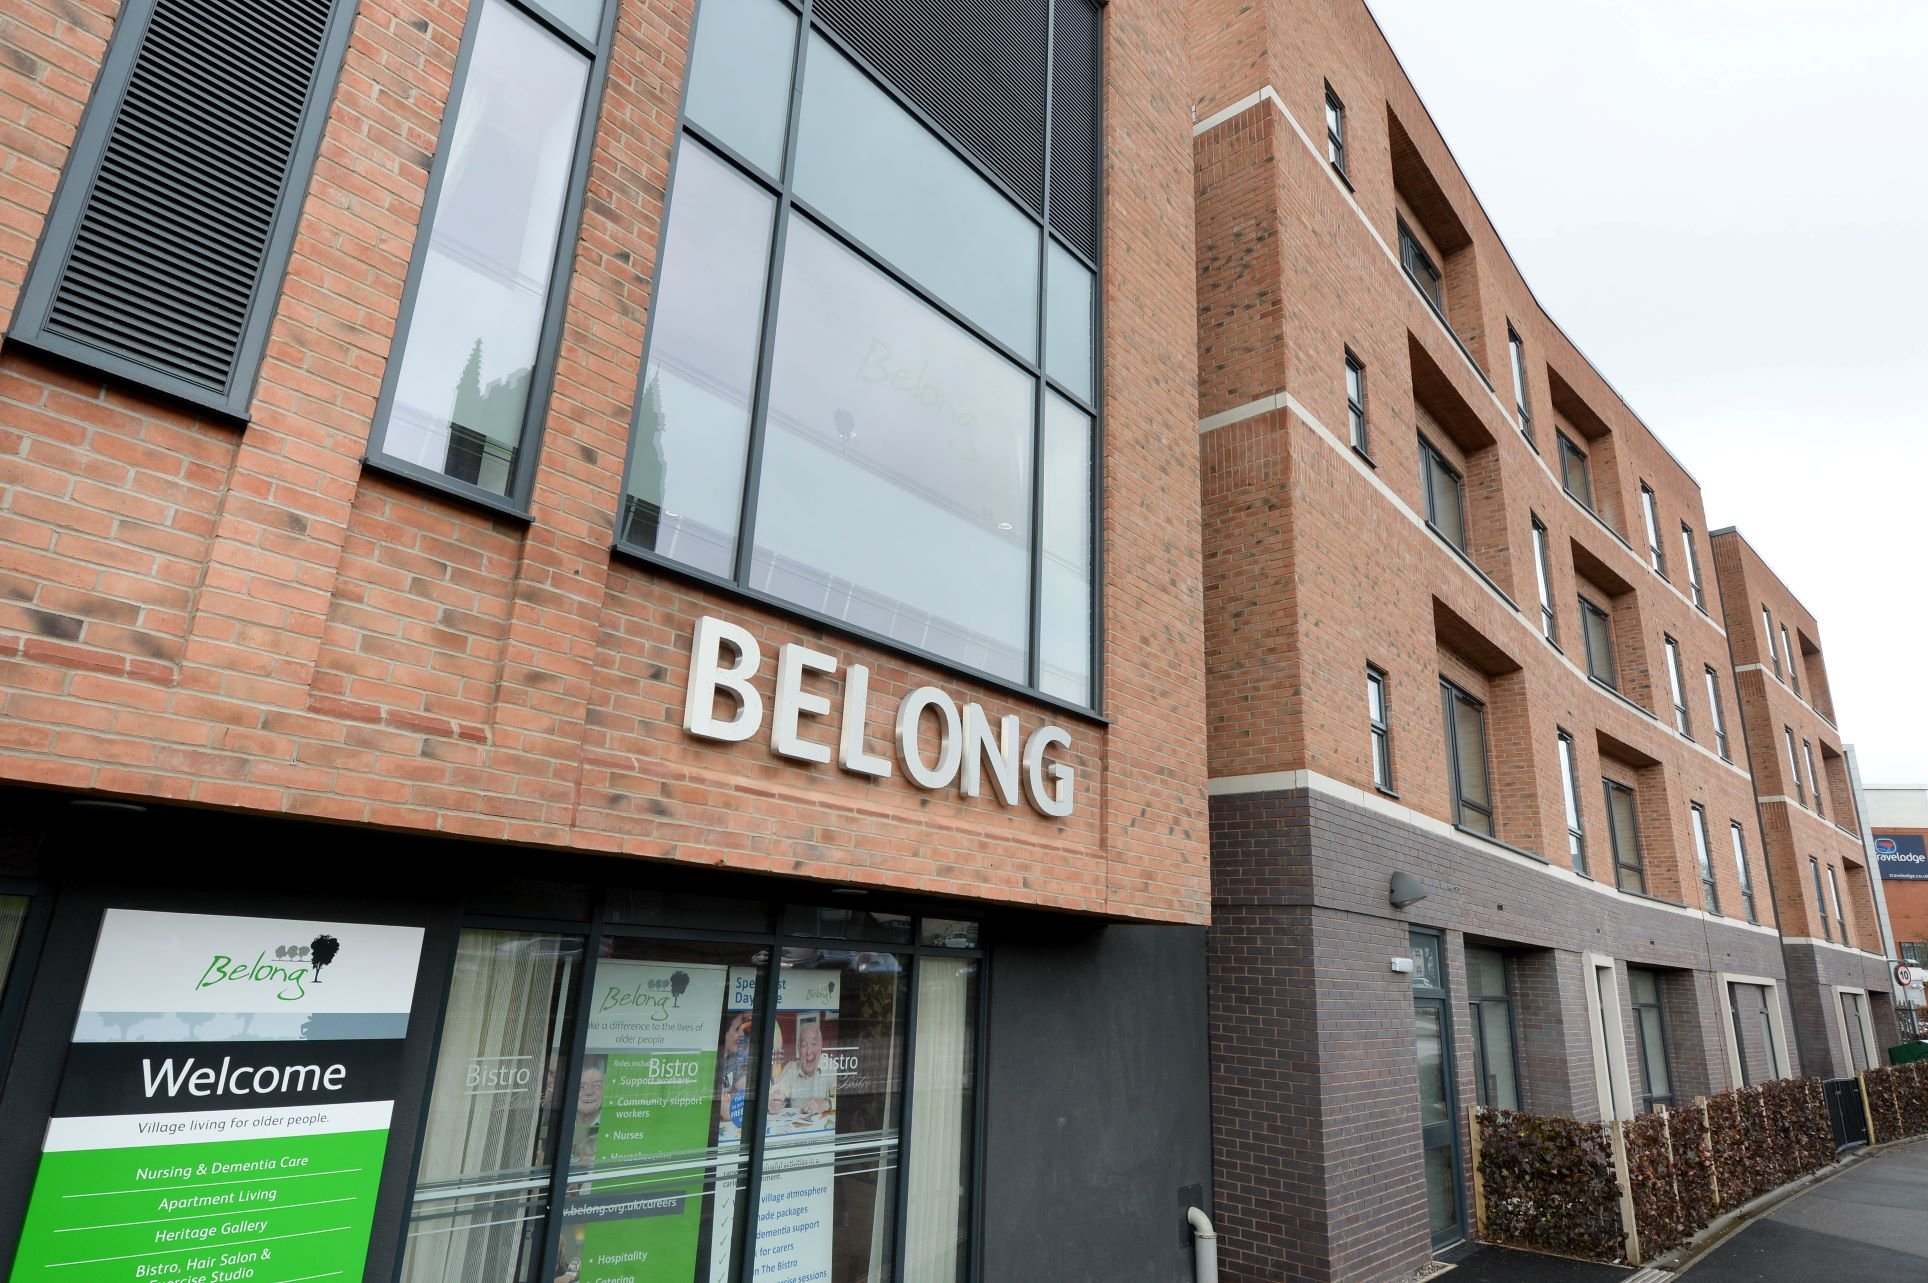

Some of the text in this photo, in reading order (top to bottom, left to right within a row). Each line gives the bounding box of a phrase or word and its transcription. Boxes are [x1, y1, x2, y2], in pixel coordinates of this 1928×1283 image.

[684, 616, 1075, 817] BELONG
[1875, 852, 1926, 864] ravelodge
[195, 951, 309, 1001] Belong
[1899, 970, 1910, 980] 10
[600, 984, 671, 1021] Belong
[587, 1021, 600, 1030] ke
[609, 1021, 650, 1031] difference
[651, 1023, 660, 1031] to
[662, 1022, 676, 1032] the
[677, 1022, 694, 1032] lives
[695, 1023, 705, 1032] of
[615, 1035, 665, 1046] older people
[648, 1058, 699, 1078] Bistro
[819, 1053, 859, 1071] Bistro
[142, 1056, 347, 1098] Welcome
[466, 1064, 530, 1087] Bistro
[617, 1096, 703, 1108] Community support
[616, 1109, 650, 1119] workers
[138, 1112, 330, 1135] Village living for older people.
[613, 1130, 644, 1141] Nurses
[136, 1156, 309, 1181] Nursing & Dementia Care
[158, 1189, 277, 1213] Apartment Living
[761, 1186, 828, 1204] village atmosphere
[776, 1205, 808, 1221] packages
[154, 1220, 268, 1243] Heritage Gallery
[756, 1220, 820, 1240] dementia support
[597, 1250, 648, 1265] Hospitality
[759, 1247, 770, 1257] for
[772, 1242, 794, 1254] carers
[136, 1248, 272, 1278] Bistro, Hair Salon &
[761, 1264, 776, 1275] The
[777, 1259, 798, 1271] Bistro
[150, 1267, 254, 1283] ercise Studio
[798, 1270, 828, 1283] sessions
